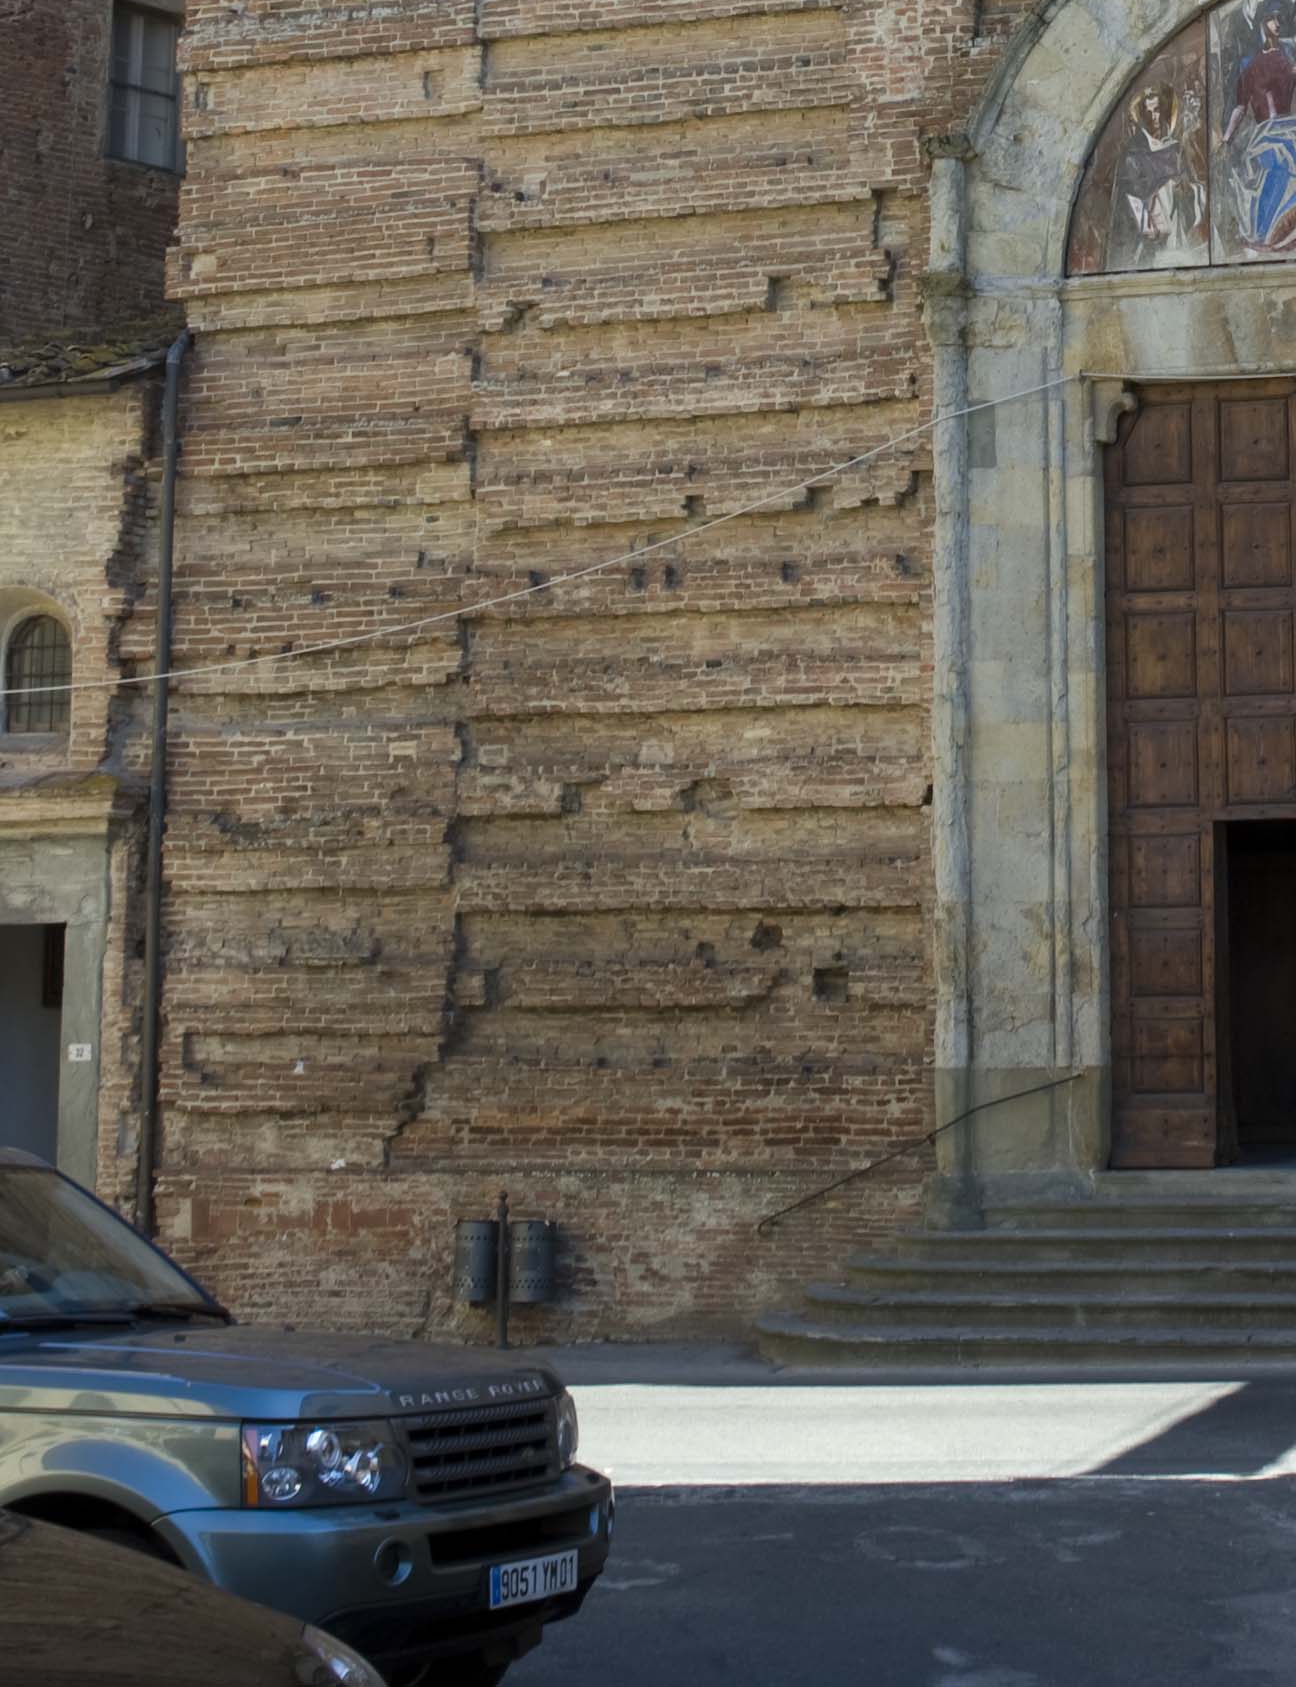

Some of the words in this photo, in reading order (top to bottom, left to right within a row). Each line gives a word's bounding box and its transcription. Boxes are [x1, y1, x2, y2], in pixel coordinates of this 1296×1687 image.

[400, 1387, 480, 1408] RANGE
[487, 1378, 545, 1398] ROVER
[502, 1563, 537, 1601] 9051
